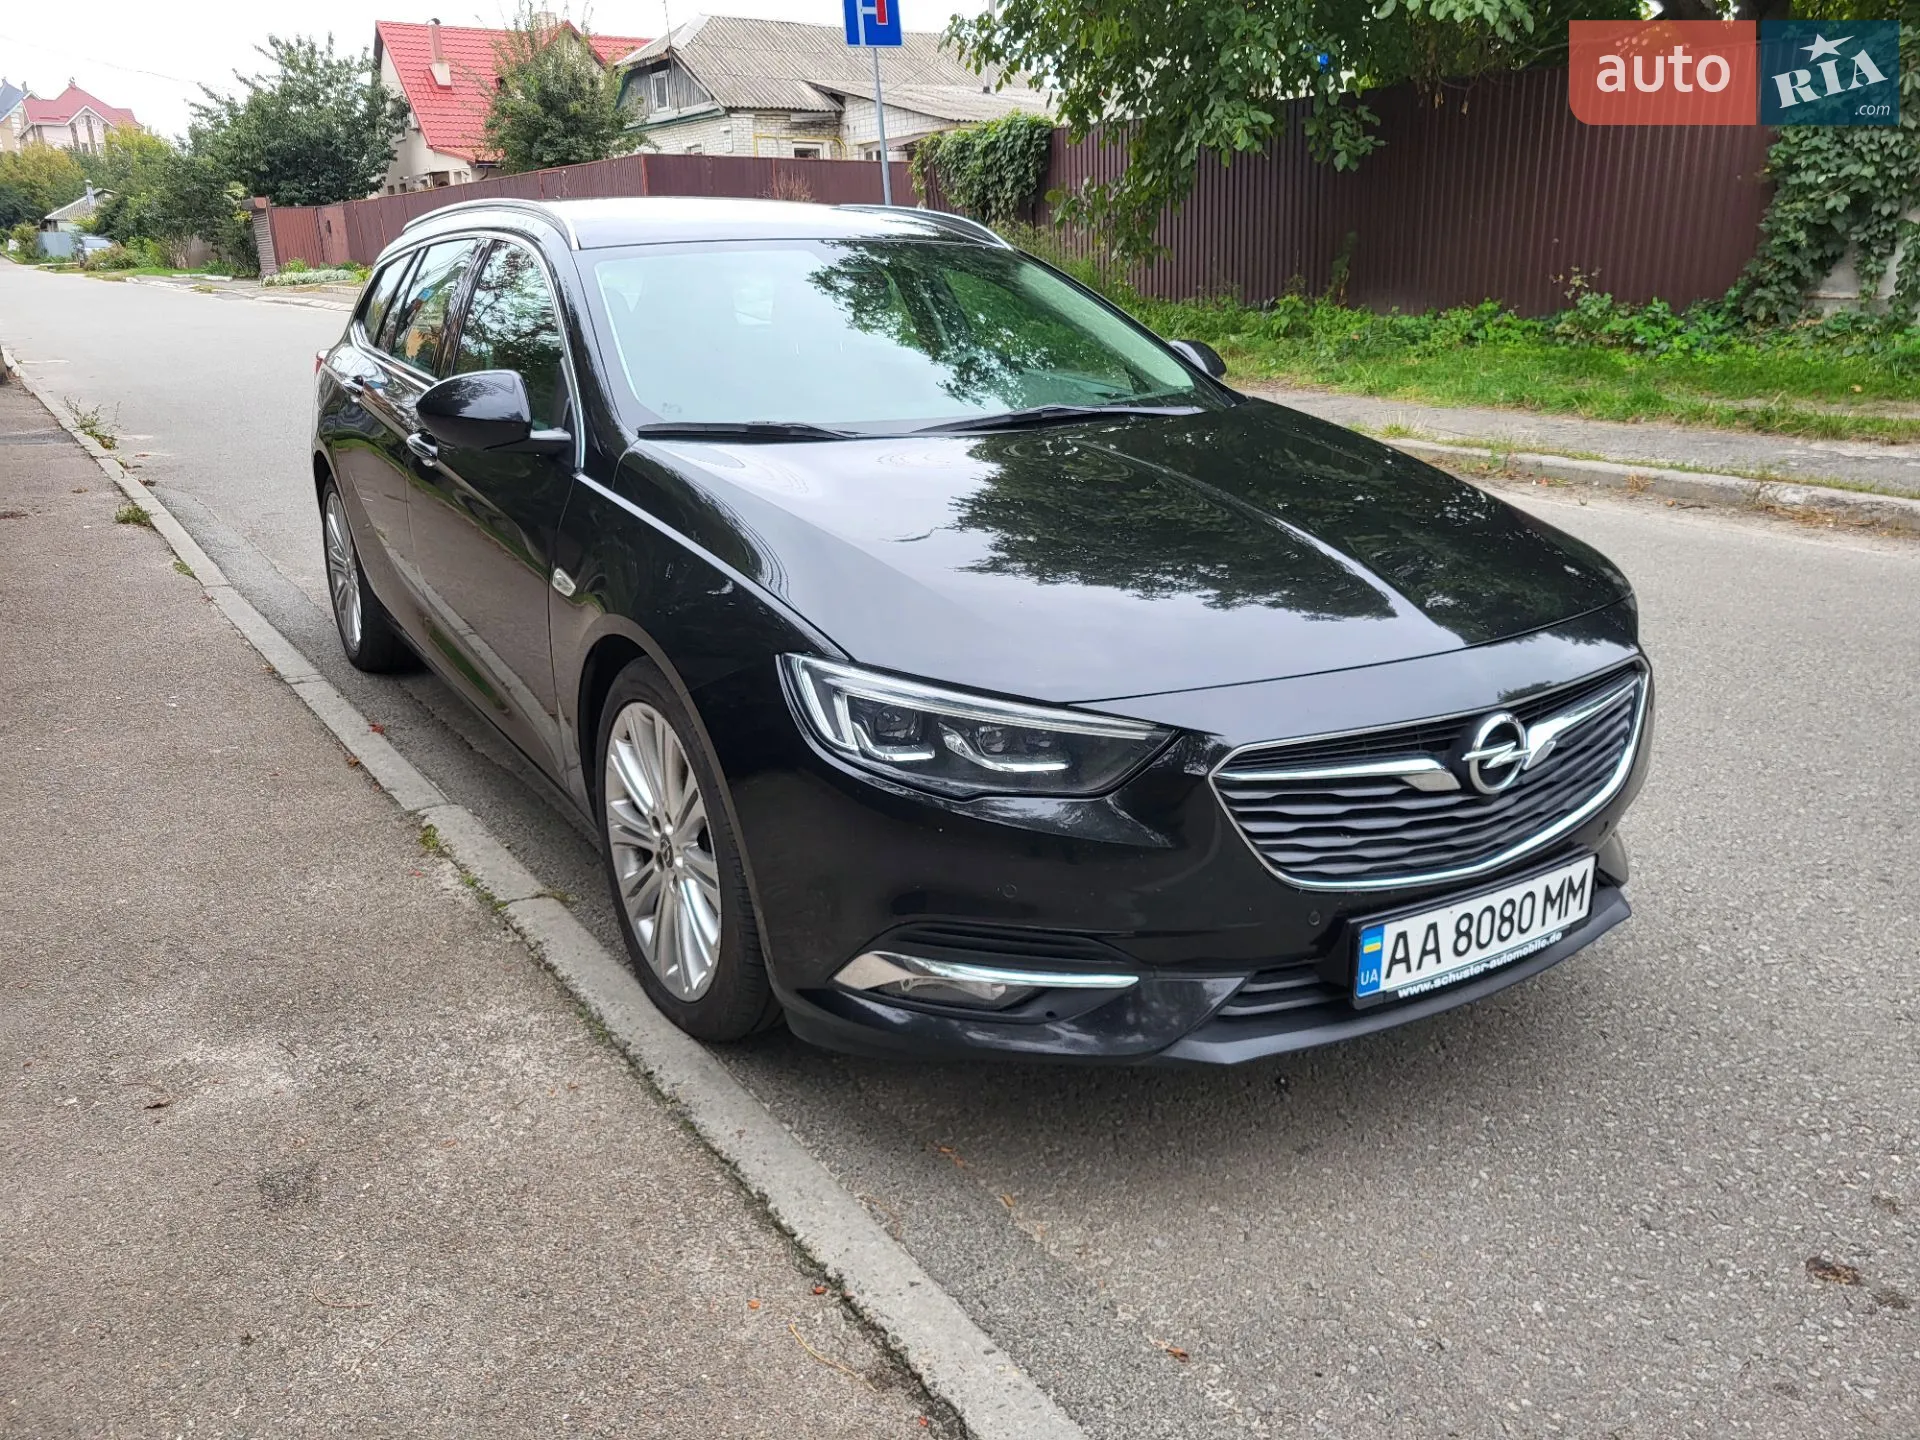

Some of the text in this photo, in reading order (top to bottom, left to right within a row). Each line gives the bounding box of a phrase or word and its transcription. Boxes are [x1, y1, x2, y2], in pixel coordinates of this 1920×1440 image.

[1385, 868, 1588, 979] AA 8080 MM
[1361, 969, 1379, 986] UA
[1398, 931, 1563, 998] www.schuster-automobile.de
